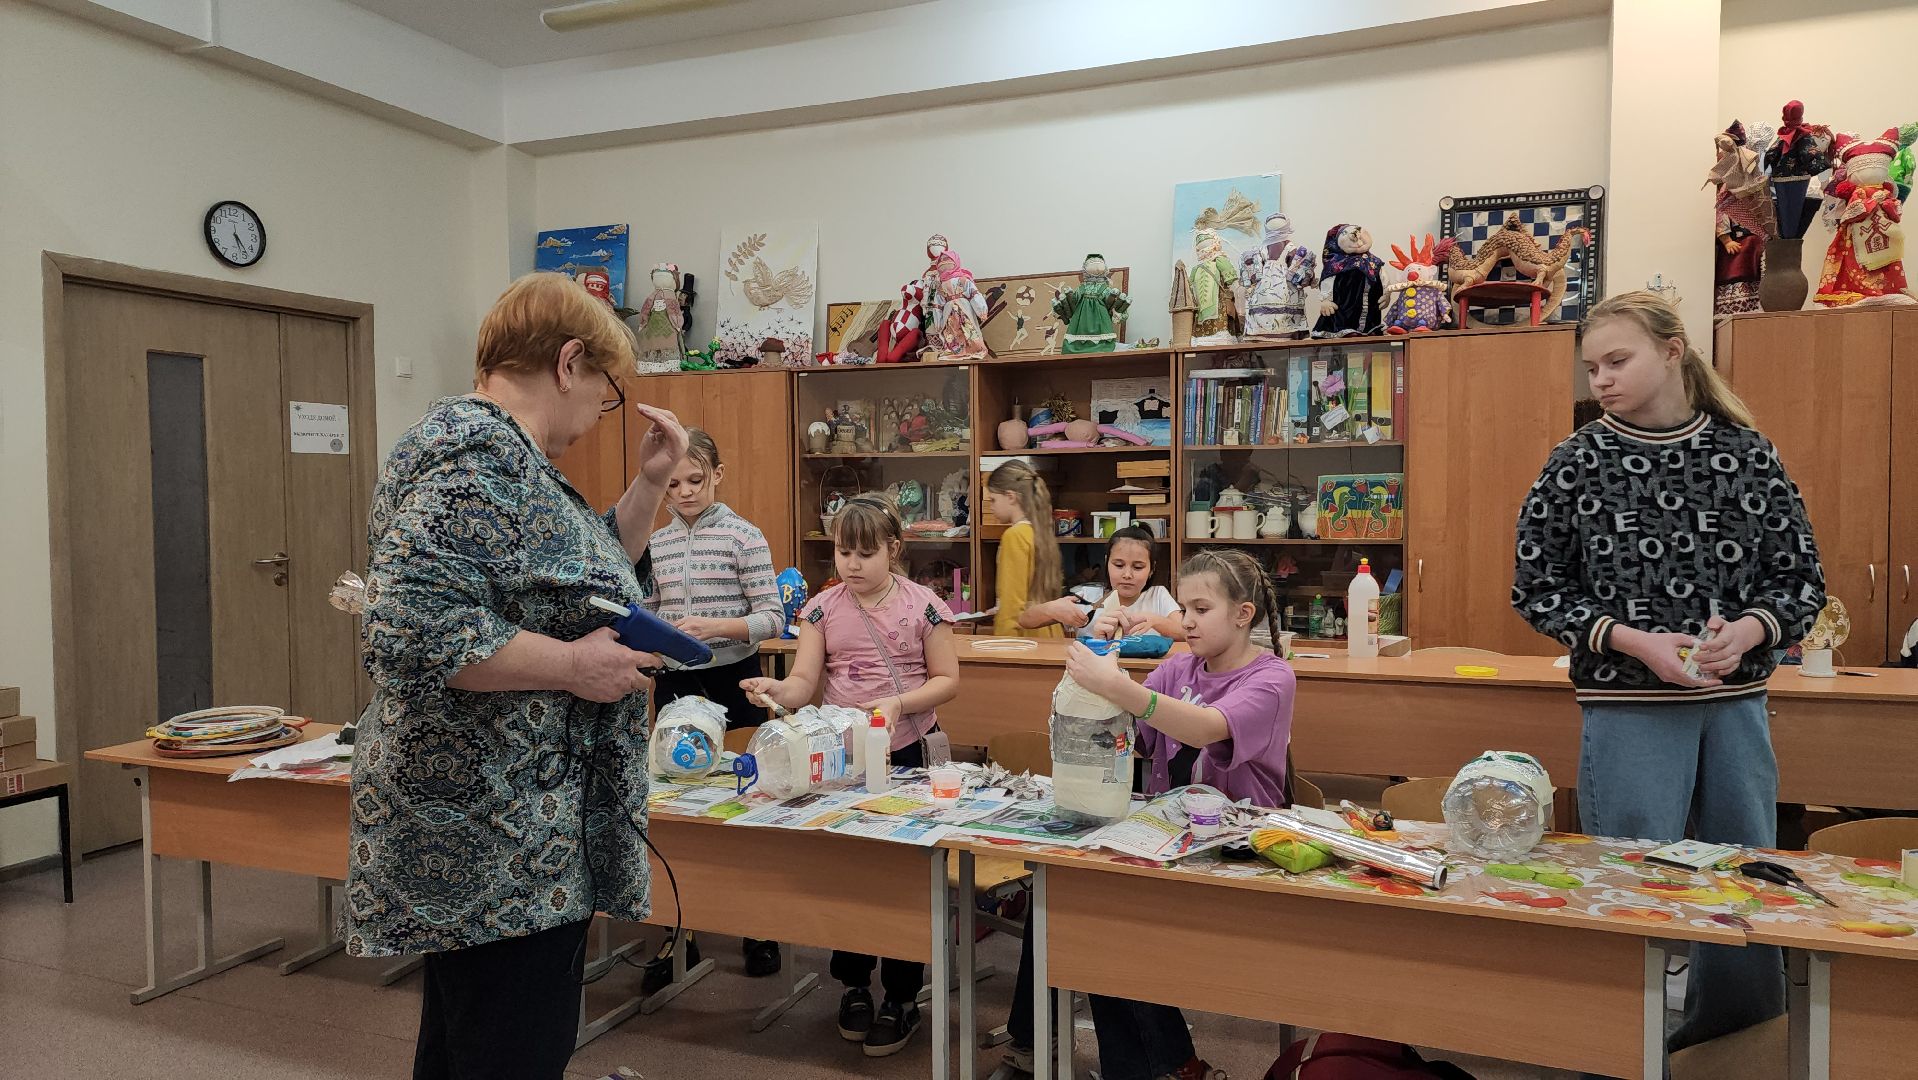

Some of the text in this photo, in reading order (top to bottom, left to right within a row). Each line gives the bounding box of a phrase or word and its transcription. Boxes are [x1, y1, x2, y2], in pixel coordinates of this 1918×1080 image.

[219, 208, 228, 219] 11
[228, 207, 239, 218] 12
[241, 213, 246, 222] 1
[211, 215, 222, 225] 10
[210, 225, 217, 235] 9
[247, 222, 255, 232] 2
[250, 233, 258, 243] 3
[221, 246, 229, 256] 7
[247, 244, 255, 253] 4
[1622, 454, 1652, 474] O
[1710, 453, 1739, 473] O
[1615, 511, 1640, 533] E
[1697, 511, 1720, 533] E
[1638, 536, 1664, 559] O
[1716, 539, 1743, 563] O
[1626, 598, 1652, 621] E
